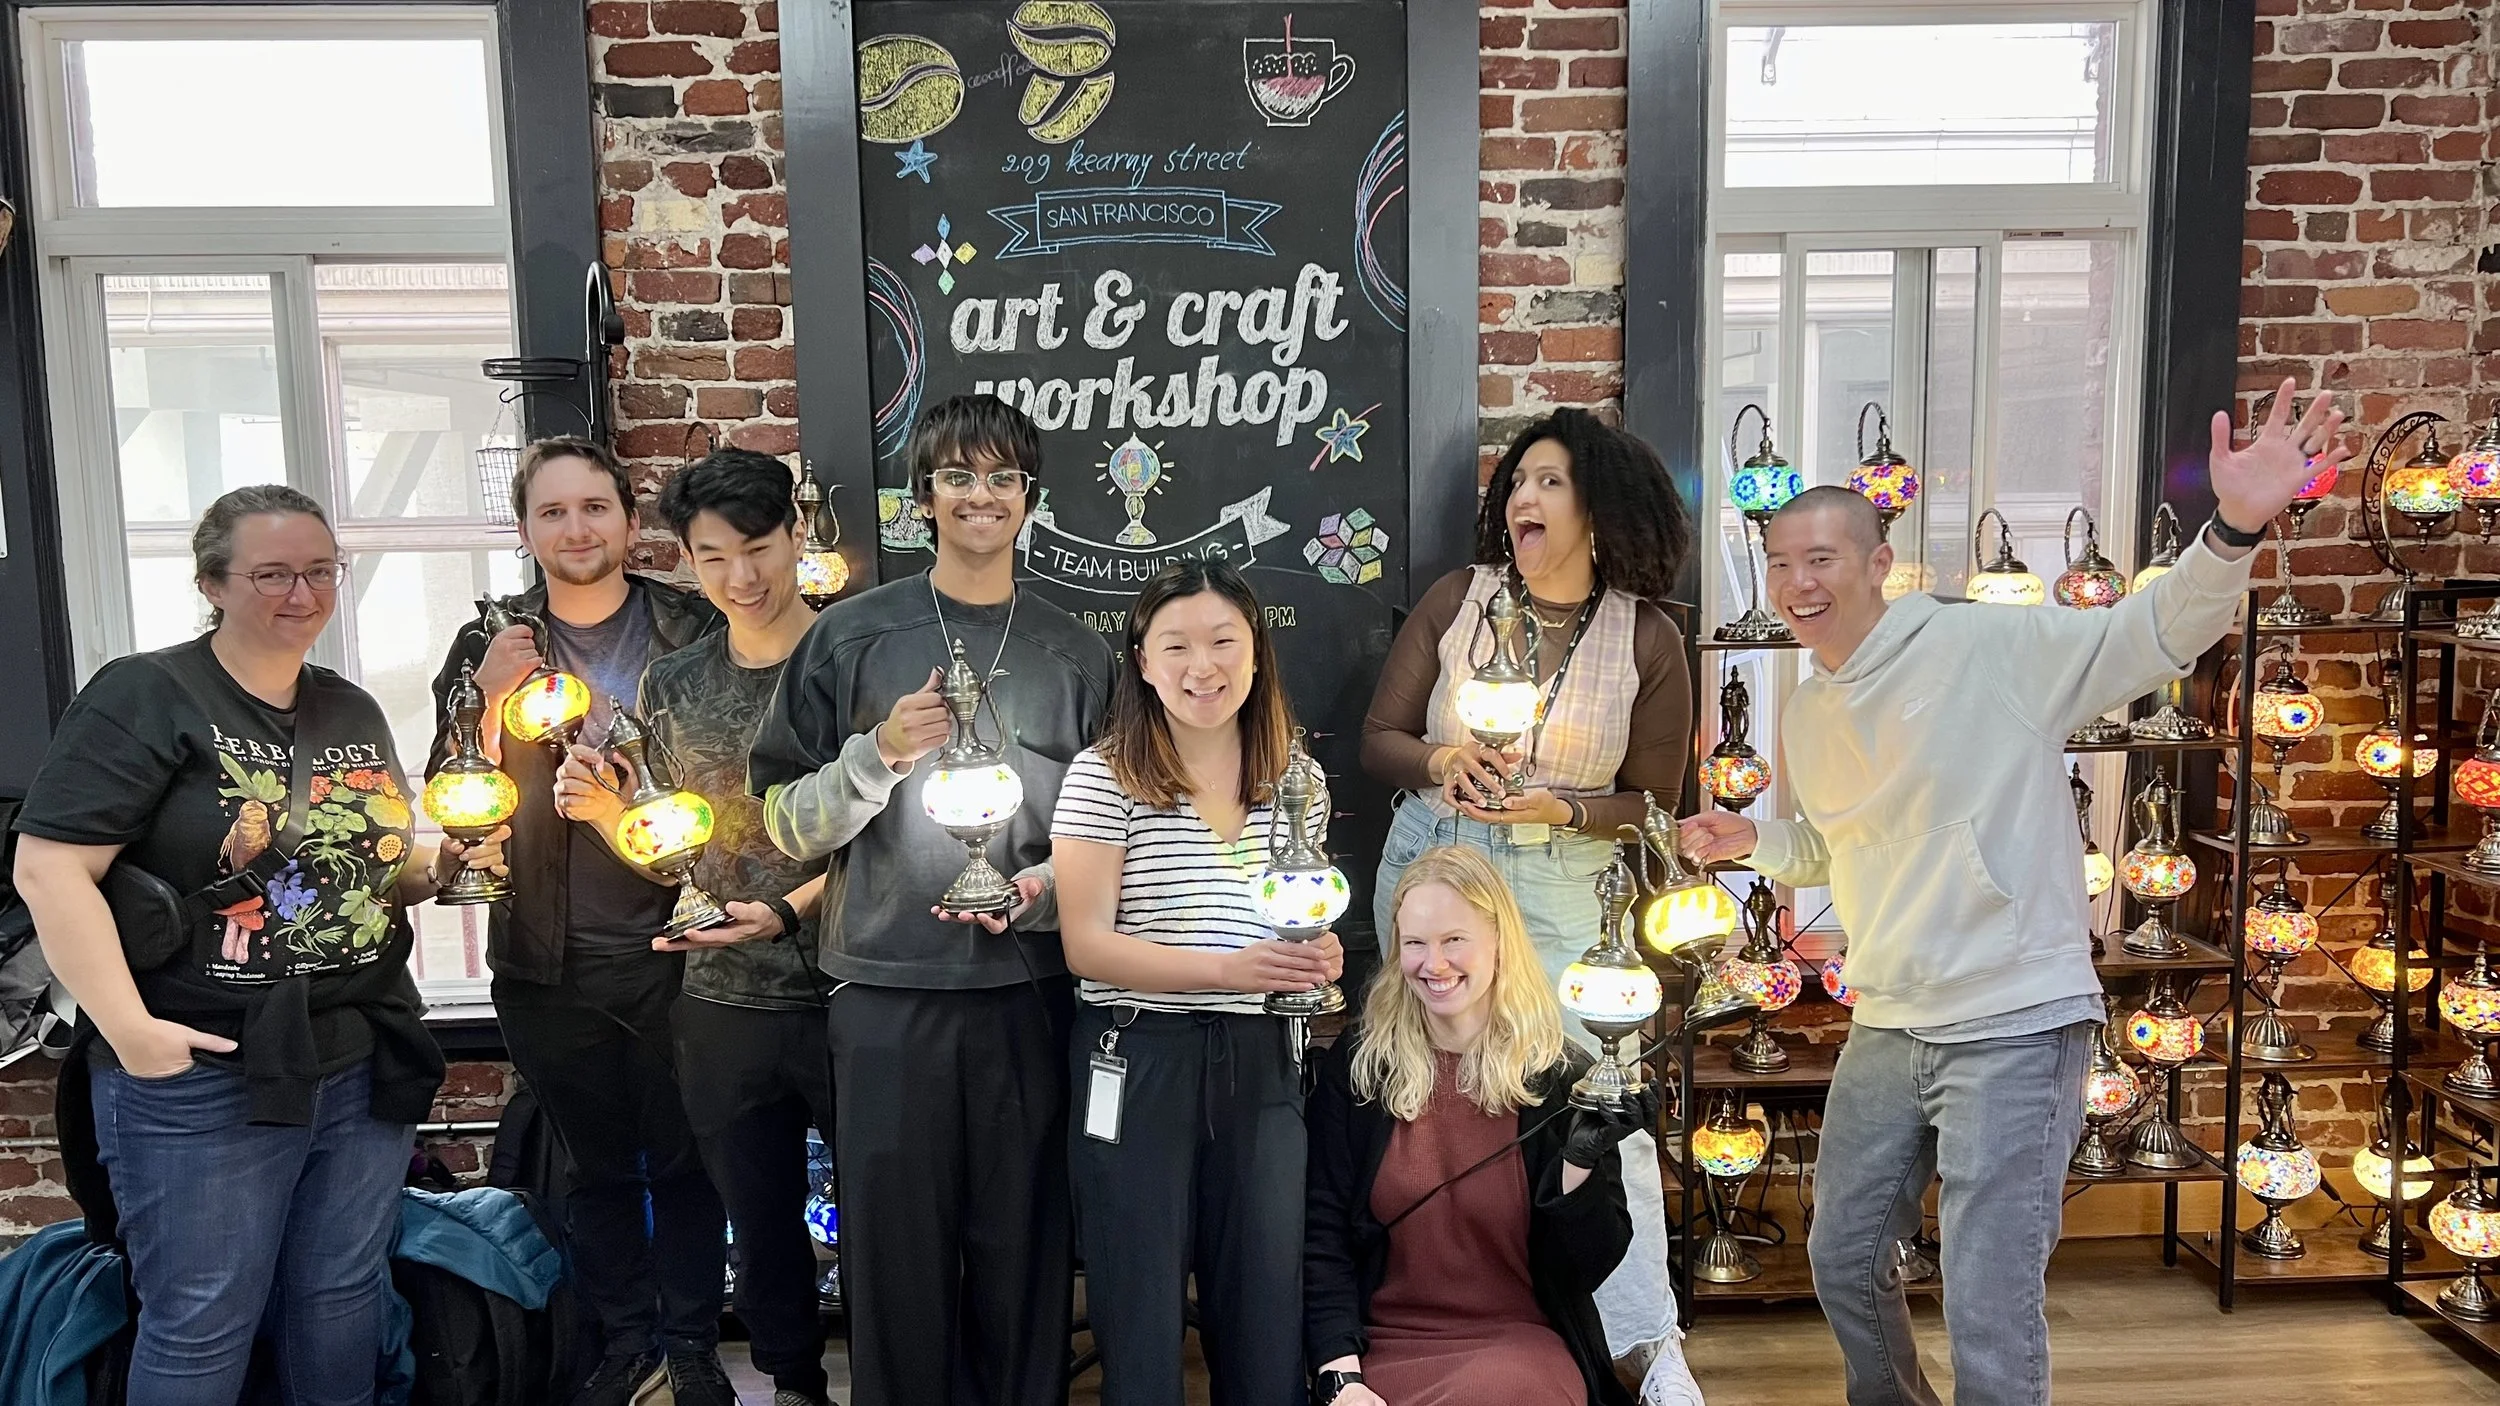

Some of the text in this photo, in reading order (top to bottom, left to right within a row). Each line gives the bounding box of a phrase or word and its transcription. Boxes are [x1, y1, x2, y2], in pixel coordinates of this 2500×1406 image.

[1066, 139, 1154, 189] kearny
[1163, 141, 1252, 173] street
[1046, 203, 1215, 228] SAN FRANCISCO
[950, 262, 1350, 367] art & craft
[1049, 542, 1228, 582] TEAM BUING
[1264, 606, 1296, 629] PM
